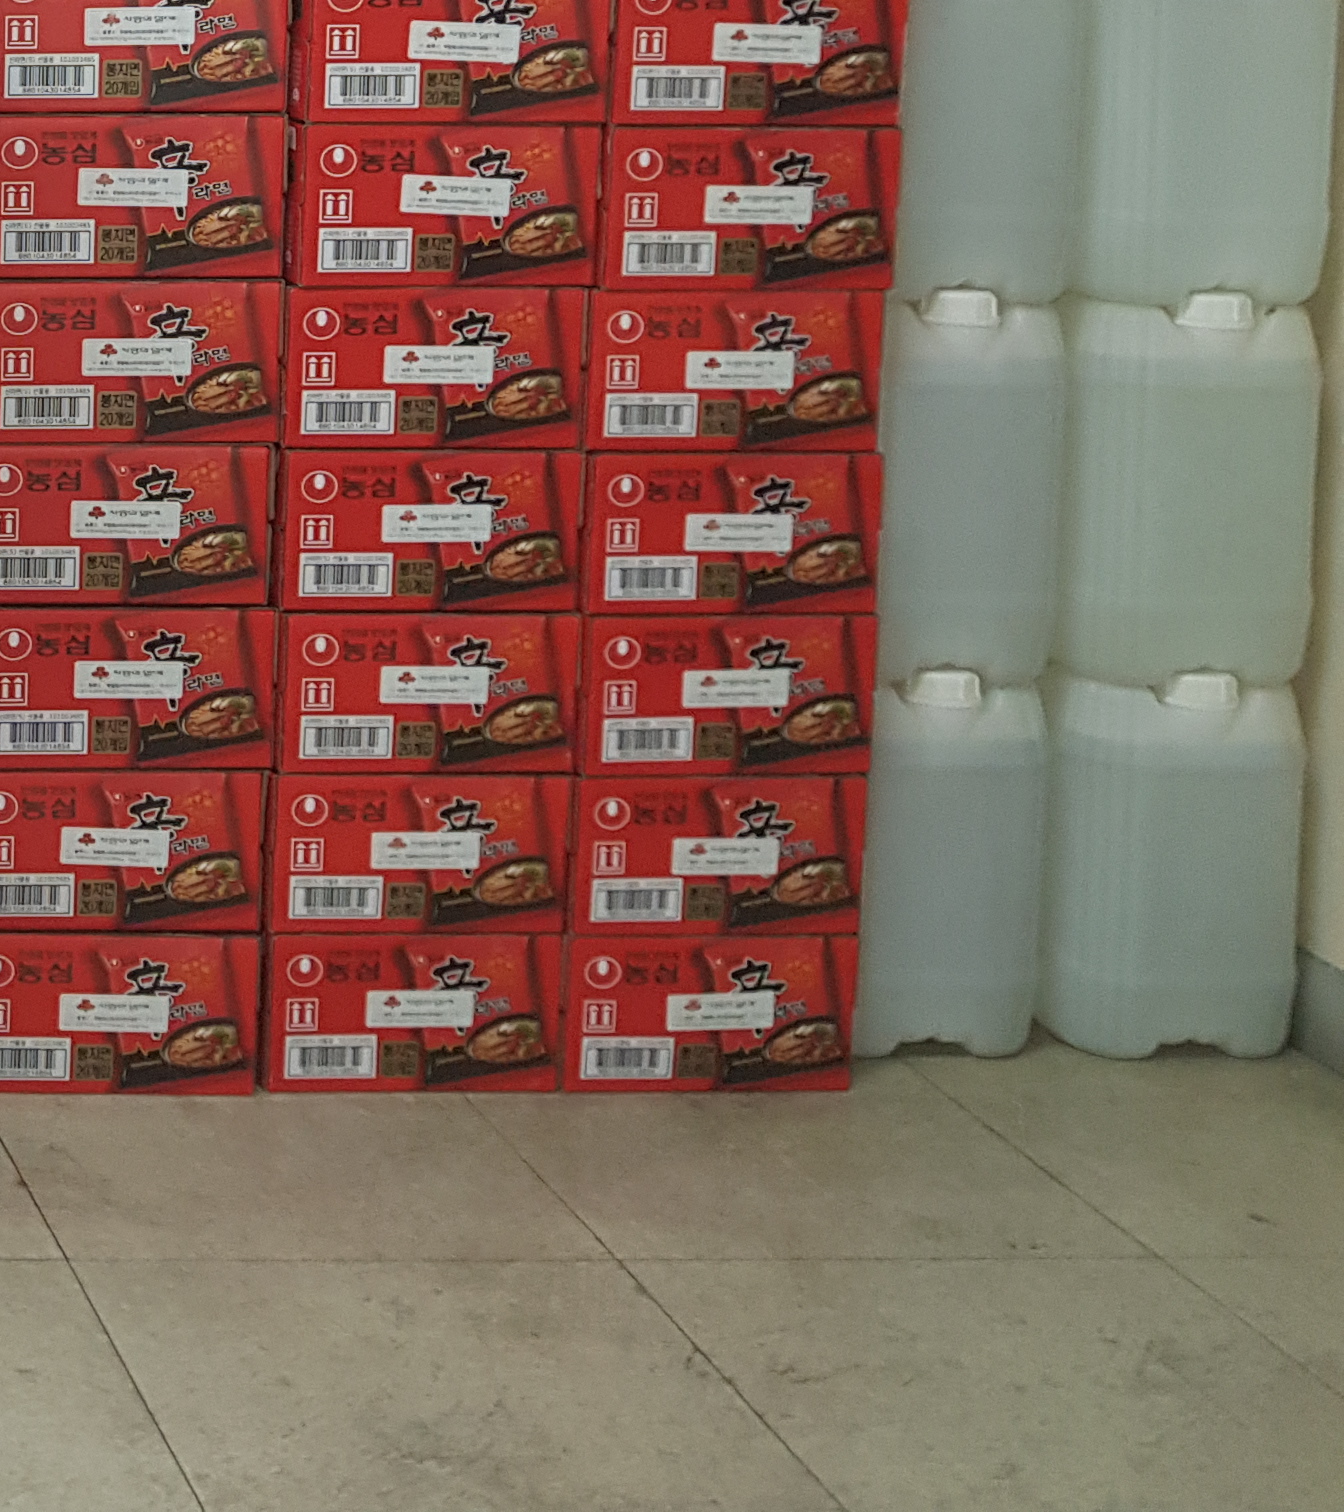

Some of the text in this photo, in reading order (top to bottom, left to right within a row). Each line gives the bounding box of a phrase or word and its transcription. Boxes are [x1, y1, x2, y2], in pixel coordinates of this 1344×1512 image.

[41, 142, 97, 164] 농심
[41, 309, 97, 331] 농심
[26, 471, 82, 493] 농심
